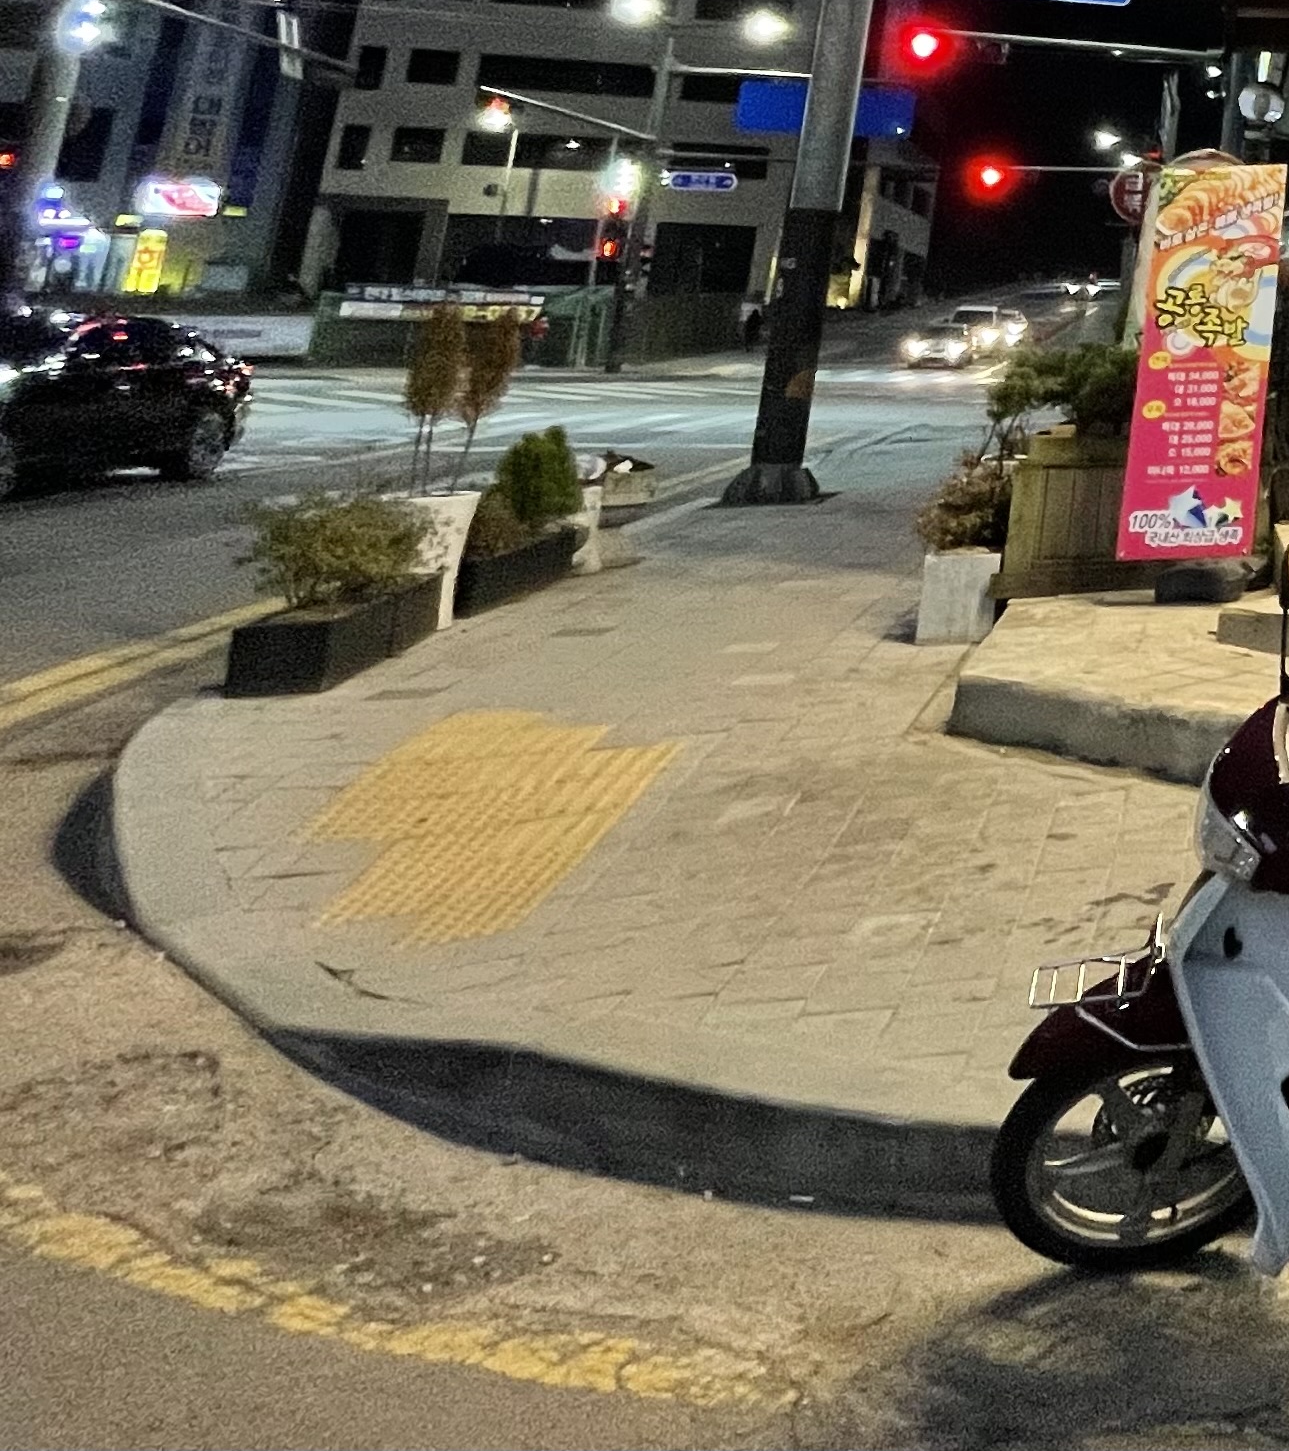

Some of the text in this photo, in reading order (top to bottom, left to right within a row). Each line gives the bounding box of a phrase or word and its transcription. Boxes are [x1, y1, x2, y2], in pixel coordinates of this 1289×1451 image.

[1153, 283, 1209, 331] 공룡
[1193, 304, 1250, 348] 족발
[1133, 512, 1172, 529] 100%
[1149, 530, 1181, 543] 국내산
